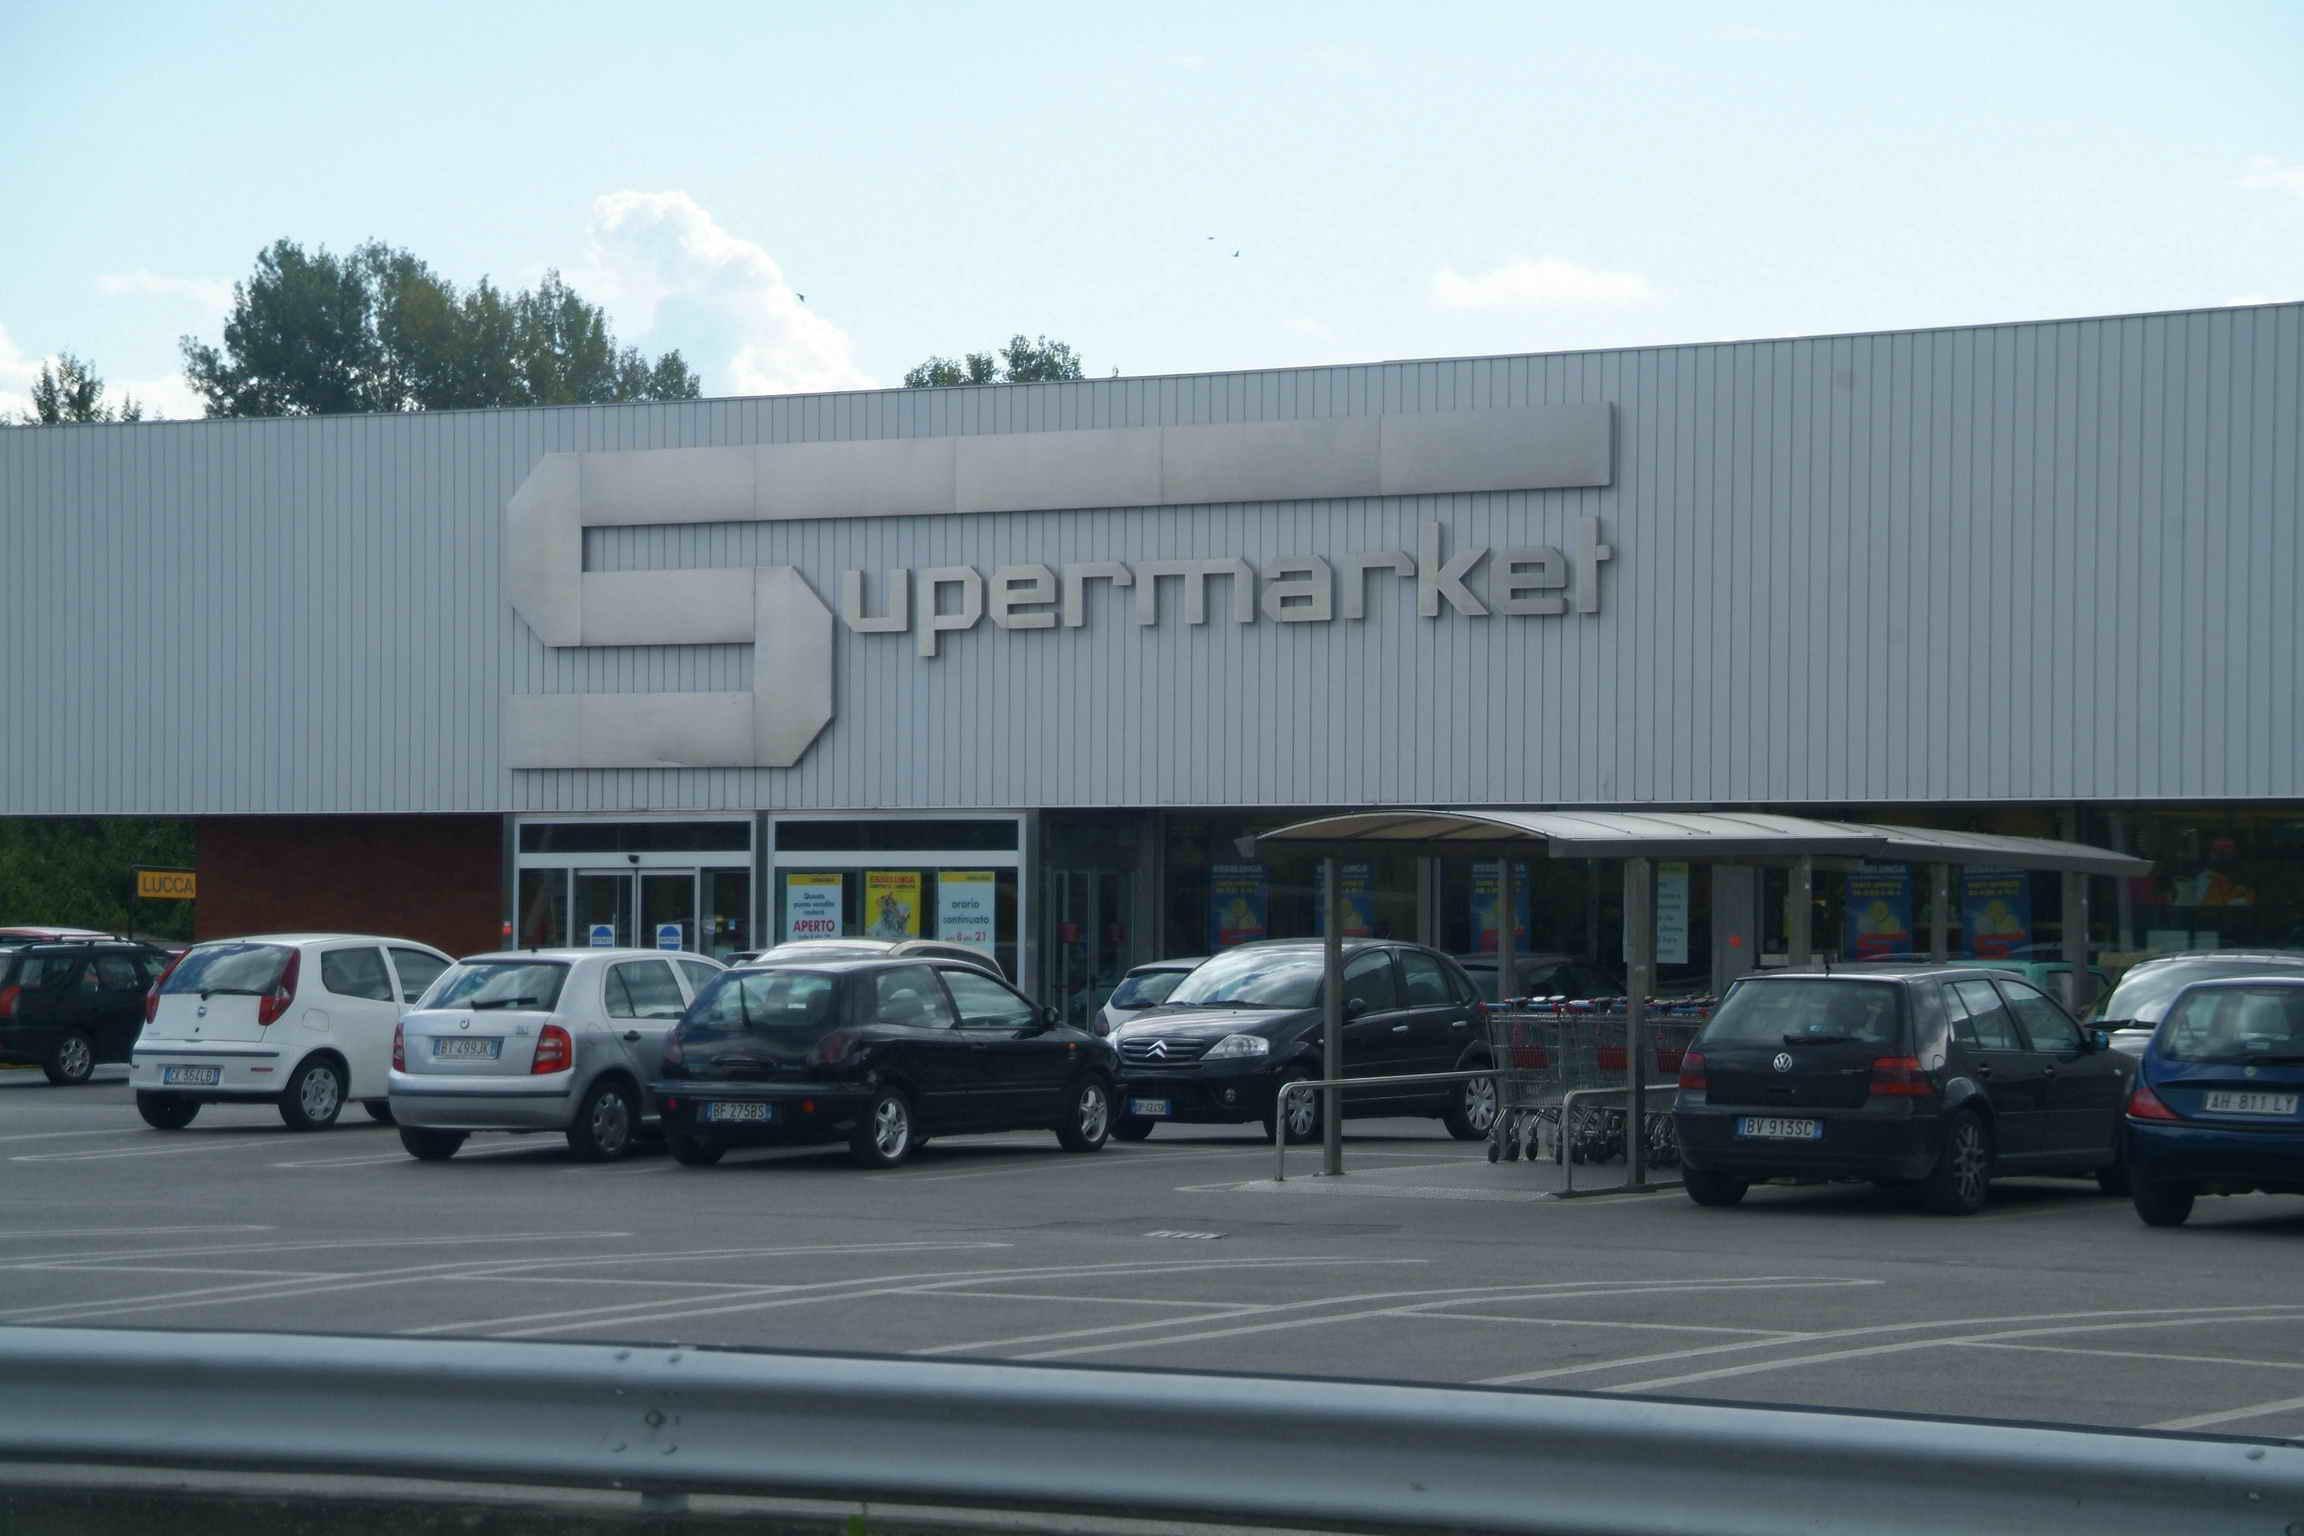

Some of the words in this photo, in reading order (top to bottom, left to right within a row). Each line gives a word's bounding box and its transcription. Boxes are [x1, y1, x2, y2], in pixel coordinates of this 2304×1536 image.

[506, 401, 1615, 769] Supermarket
[143, 876, 194, 893] LUCCA
[951, 896, 980, 909] orario
[793, 919, 836, 932] APERTO
[943, 915, 989, 924] continuato
[2211, 1094, 2231, 1109] AH
[1746, 1119, 1764, 1134] BV
[1769, 1120, 1812, 1137] 913SC
